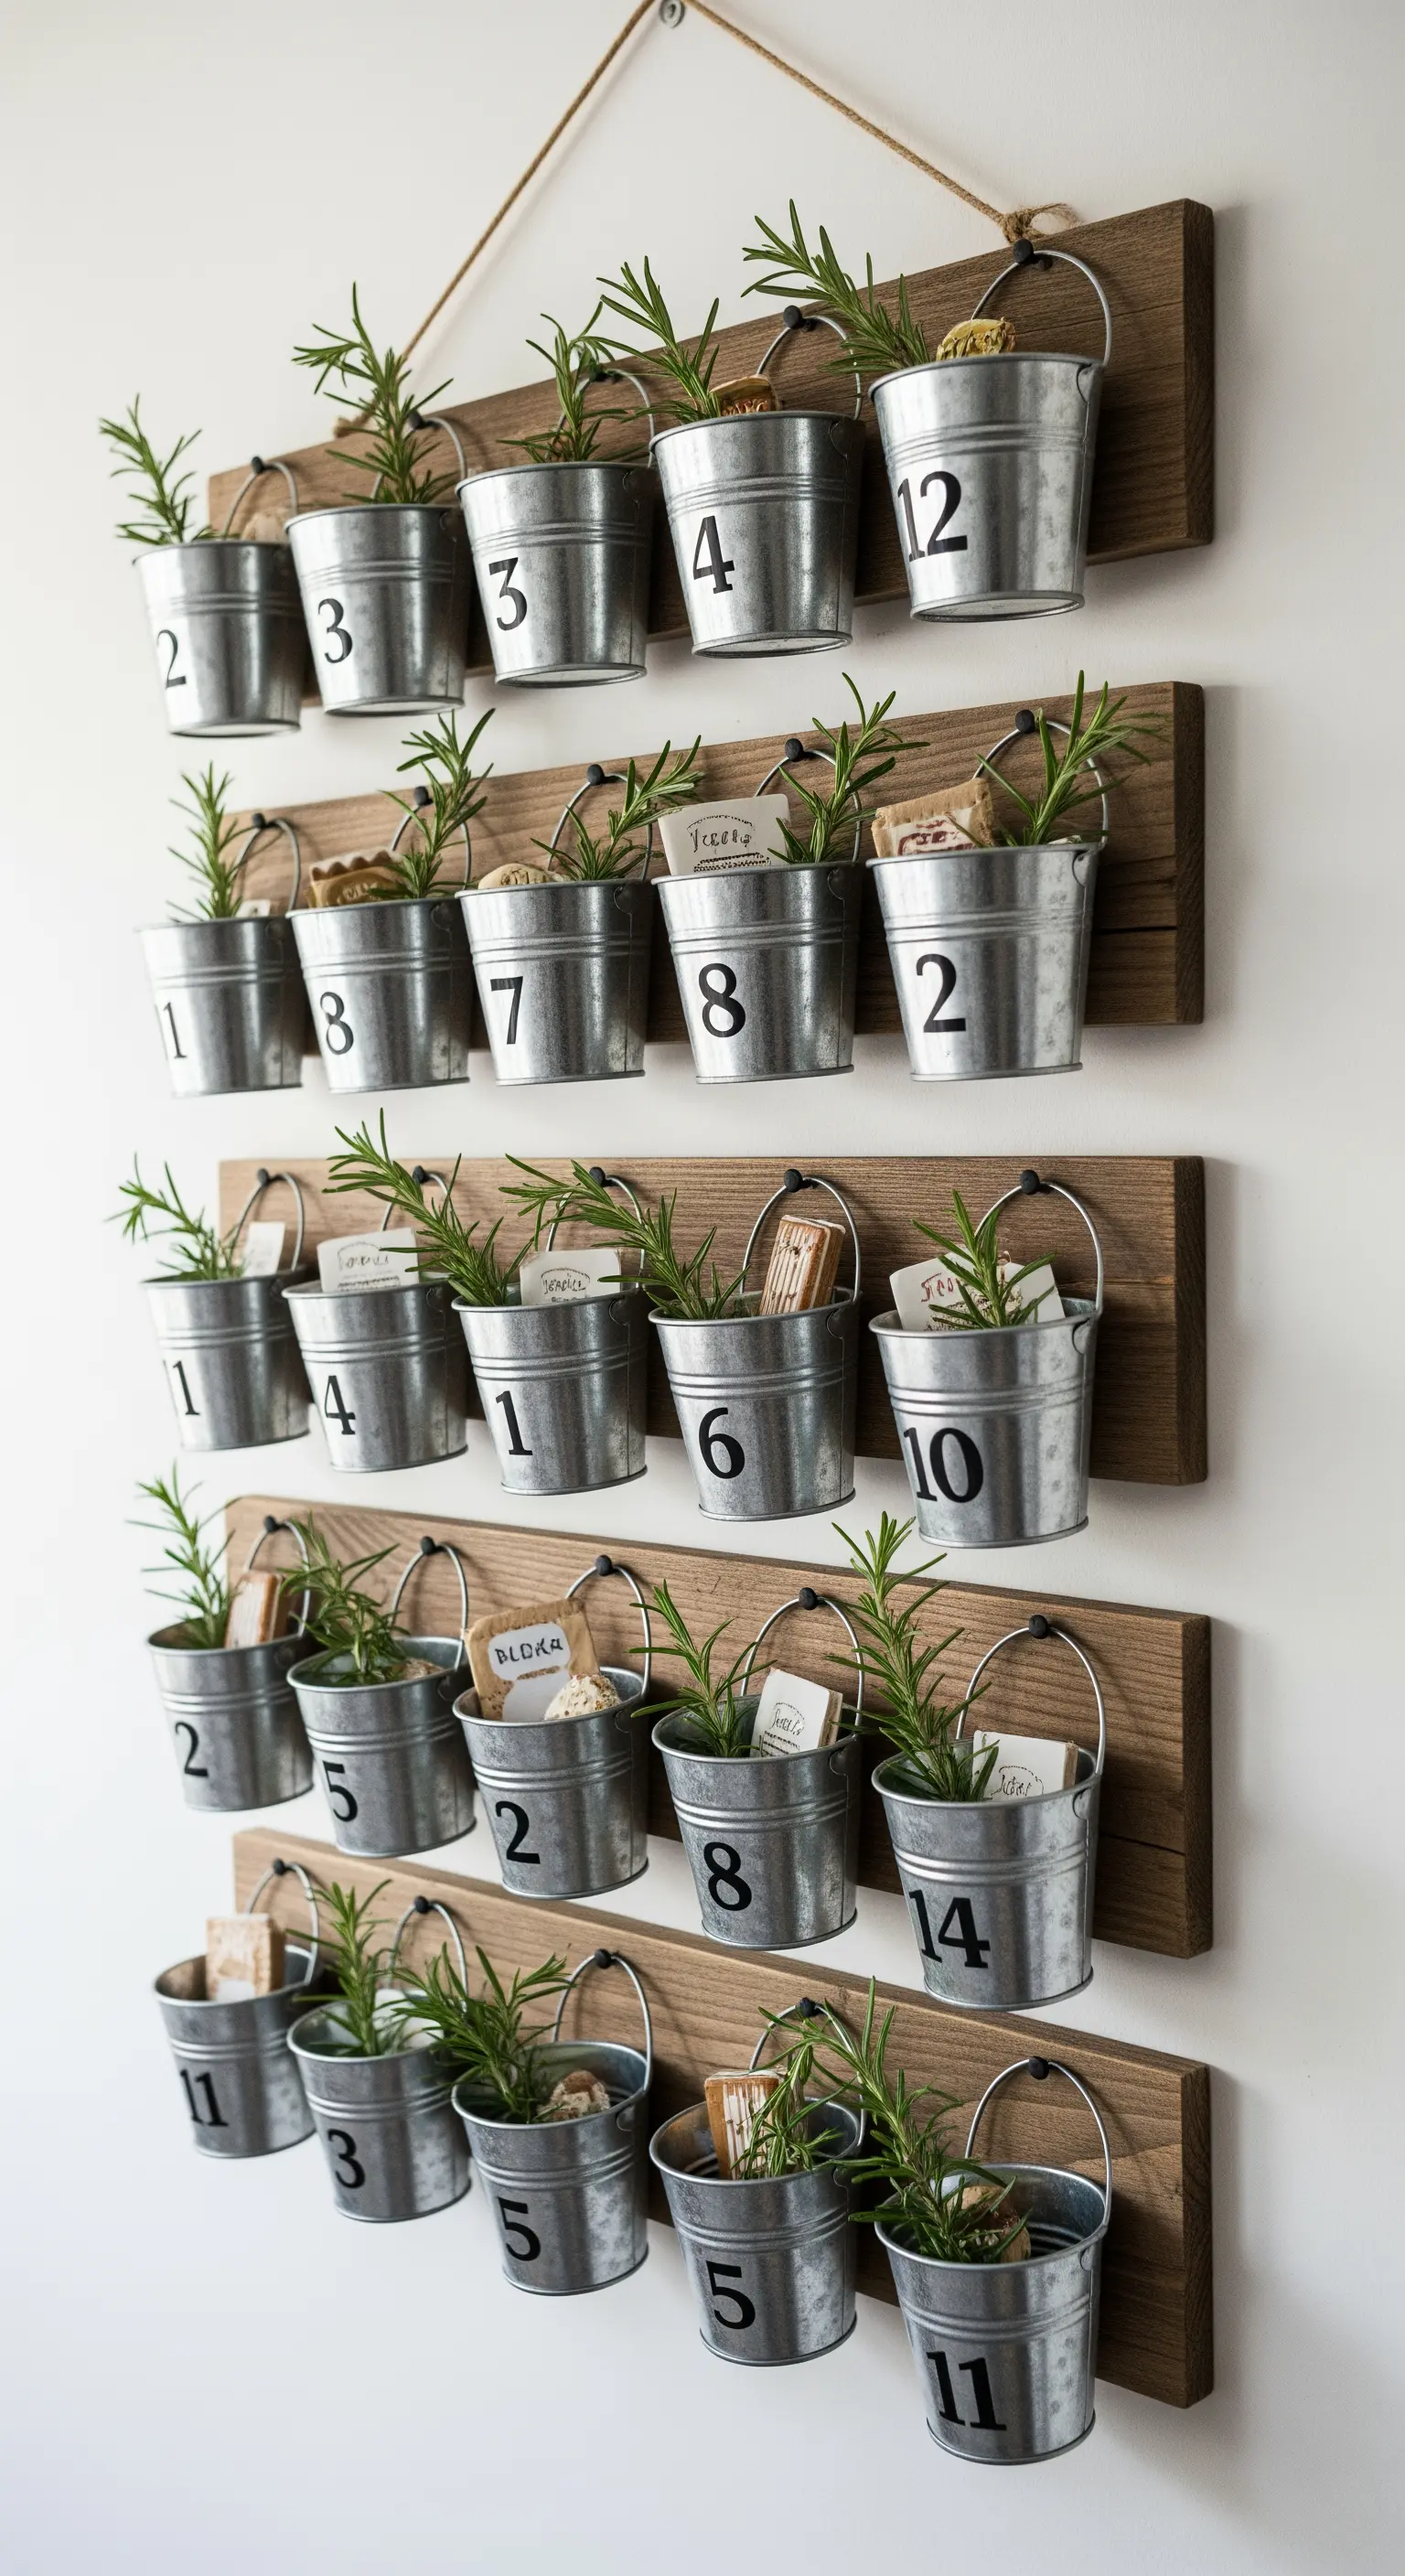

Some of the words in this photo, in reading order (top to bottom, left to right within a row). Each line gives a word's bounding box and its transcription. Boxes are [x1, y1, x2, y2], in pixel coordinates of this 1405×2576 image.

[897, 471, 968, 562] 12
[692, 516, 735, 594] 4
[488, 558, 528, 631] 3
[156, 629, 188, 689] 2
[317, 598, 352, 663] 3
[318, 992, 353, 1055] 8
[490, 977, 523, 1045] 7
[699, 963, 745, 1037] 8
[917, 953, 966, 1033] 2
[162, 1002, 187, 1058] 1
[326, 1375, 356, 1435] 4
[496, 1391, 532, 1455] 1
[699, 1408, 745, 1479] 6
[904, 1428, 983, 1503] 10
[175, 1722, 209, 1777] 2
[323, 1761, 358, 1821] 5
[496, 1801, 541, 1864] 2
[703, 1841, 752, 1911] 8
[910, 1890, 991, 1969] 14
[179, 2069, 228, 2127] 11
[328, 2130, 365, 2188] 3
[498, 2196, 542, 2260] 5
[706, 2261, 756, 2329] 5
[927, 2351, 1007, 2431] 11
